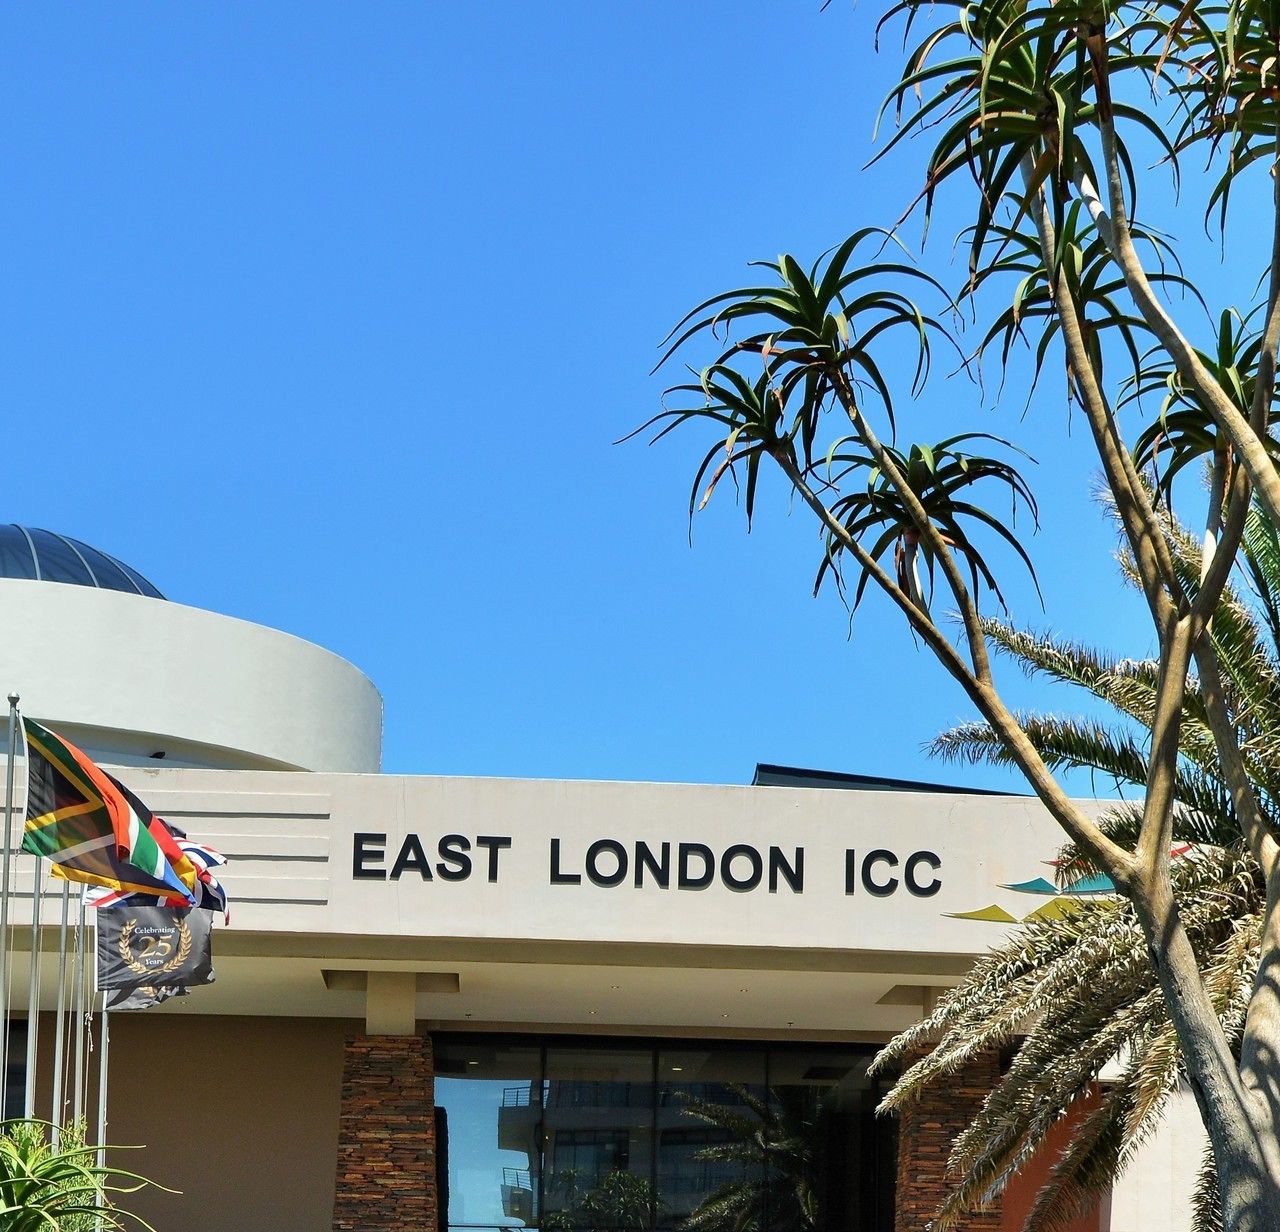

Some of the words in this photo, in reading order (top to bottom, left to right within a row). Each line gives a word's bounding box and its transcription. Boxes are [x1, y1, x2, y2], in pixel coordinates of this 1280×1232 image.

[352, 832, 512, 883] EAST
[549, 837, 805, 894] LONDON
[844, 848, 942, 898] ICC
[134, 926, 176, 935] Celebrating
[138, 934, 172, 958] 25
[145, 958, 164, 966] Years
